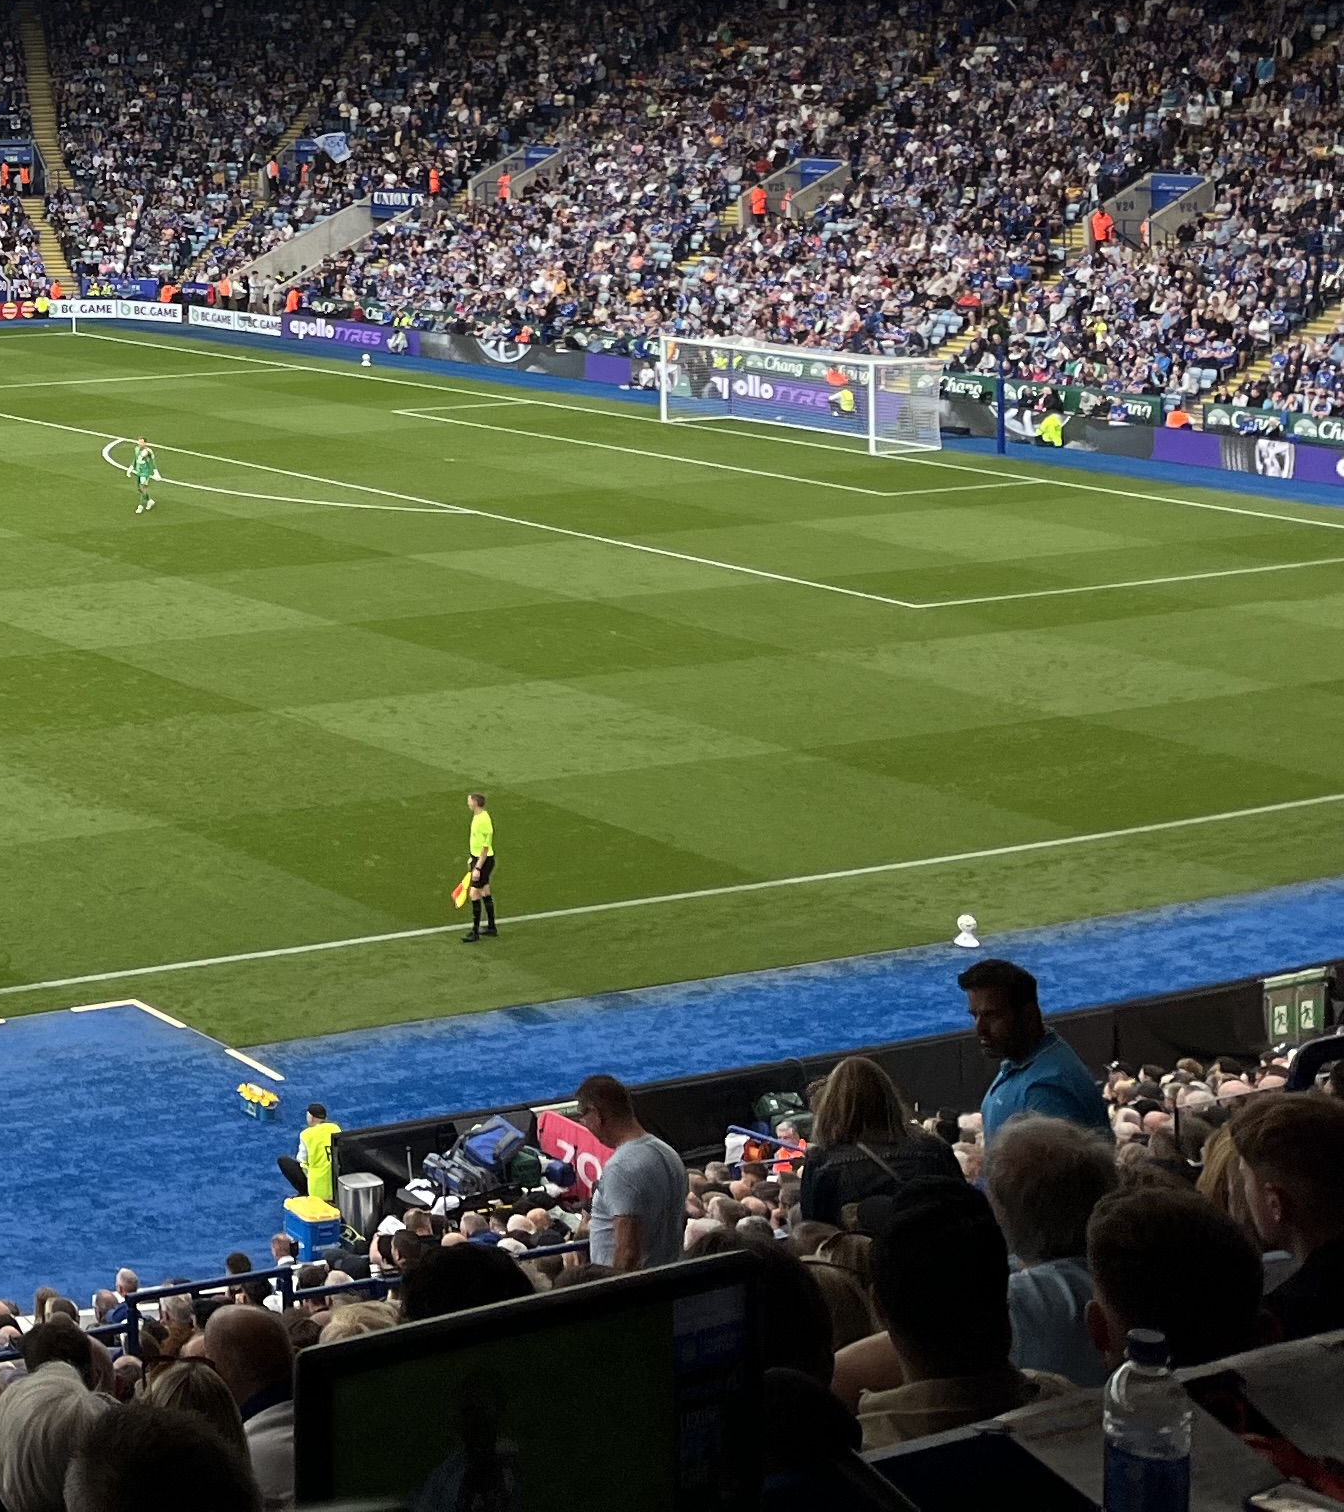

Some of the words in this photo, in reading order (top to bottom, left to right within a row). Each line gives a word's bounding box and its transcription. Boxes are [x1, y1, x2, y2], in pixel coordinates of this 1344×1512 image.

[373, 191, 408, 206] UNION
[1116, 201, 1134, 212] V24
[134, 305, 178, 317] BC.GAME
[200, 311, 232, 326] BC.GAME
[290, 317, 336, 340] apollo
[334, 326, 382, 345] TYRES
[764, 355, 804, 377] Chang
[939, 375, 983, 399] Chang
